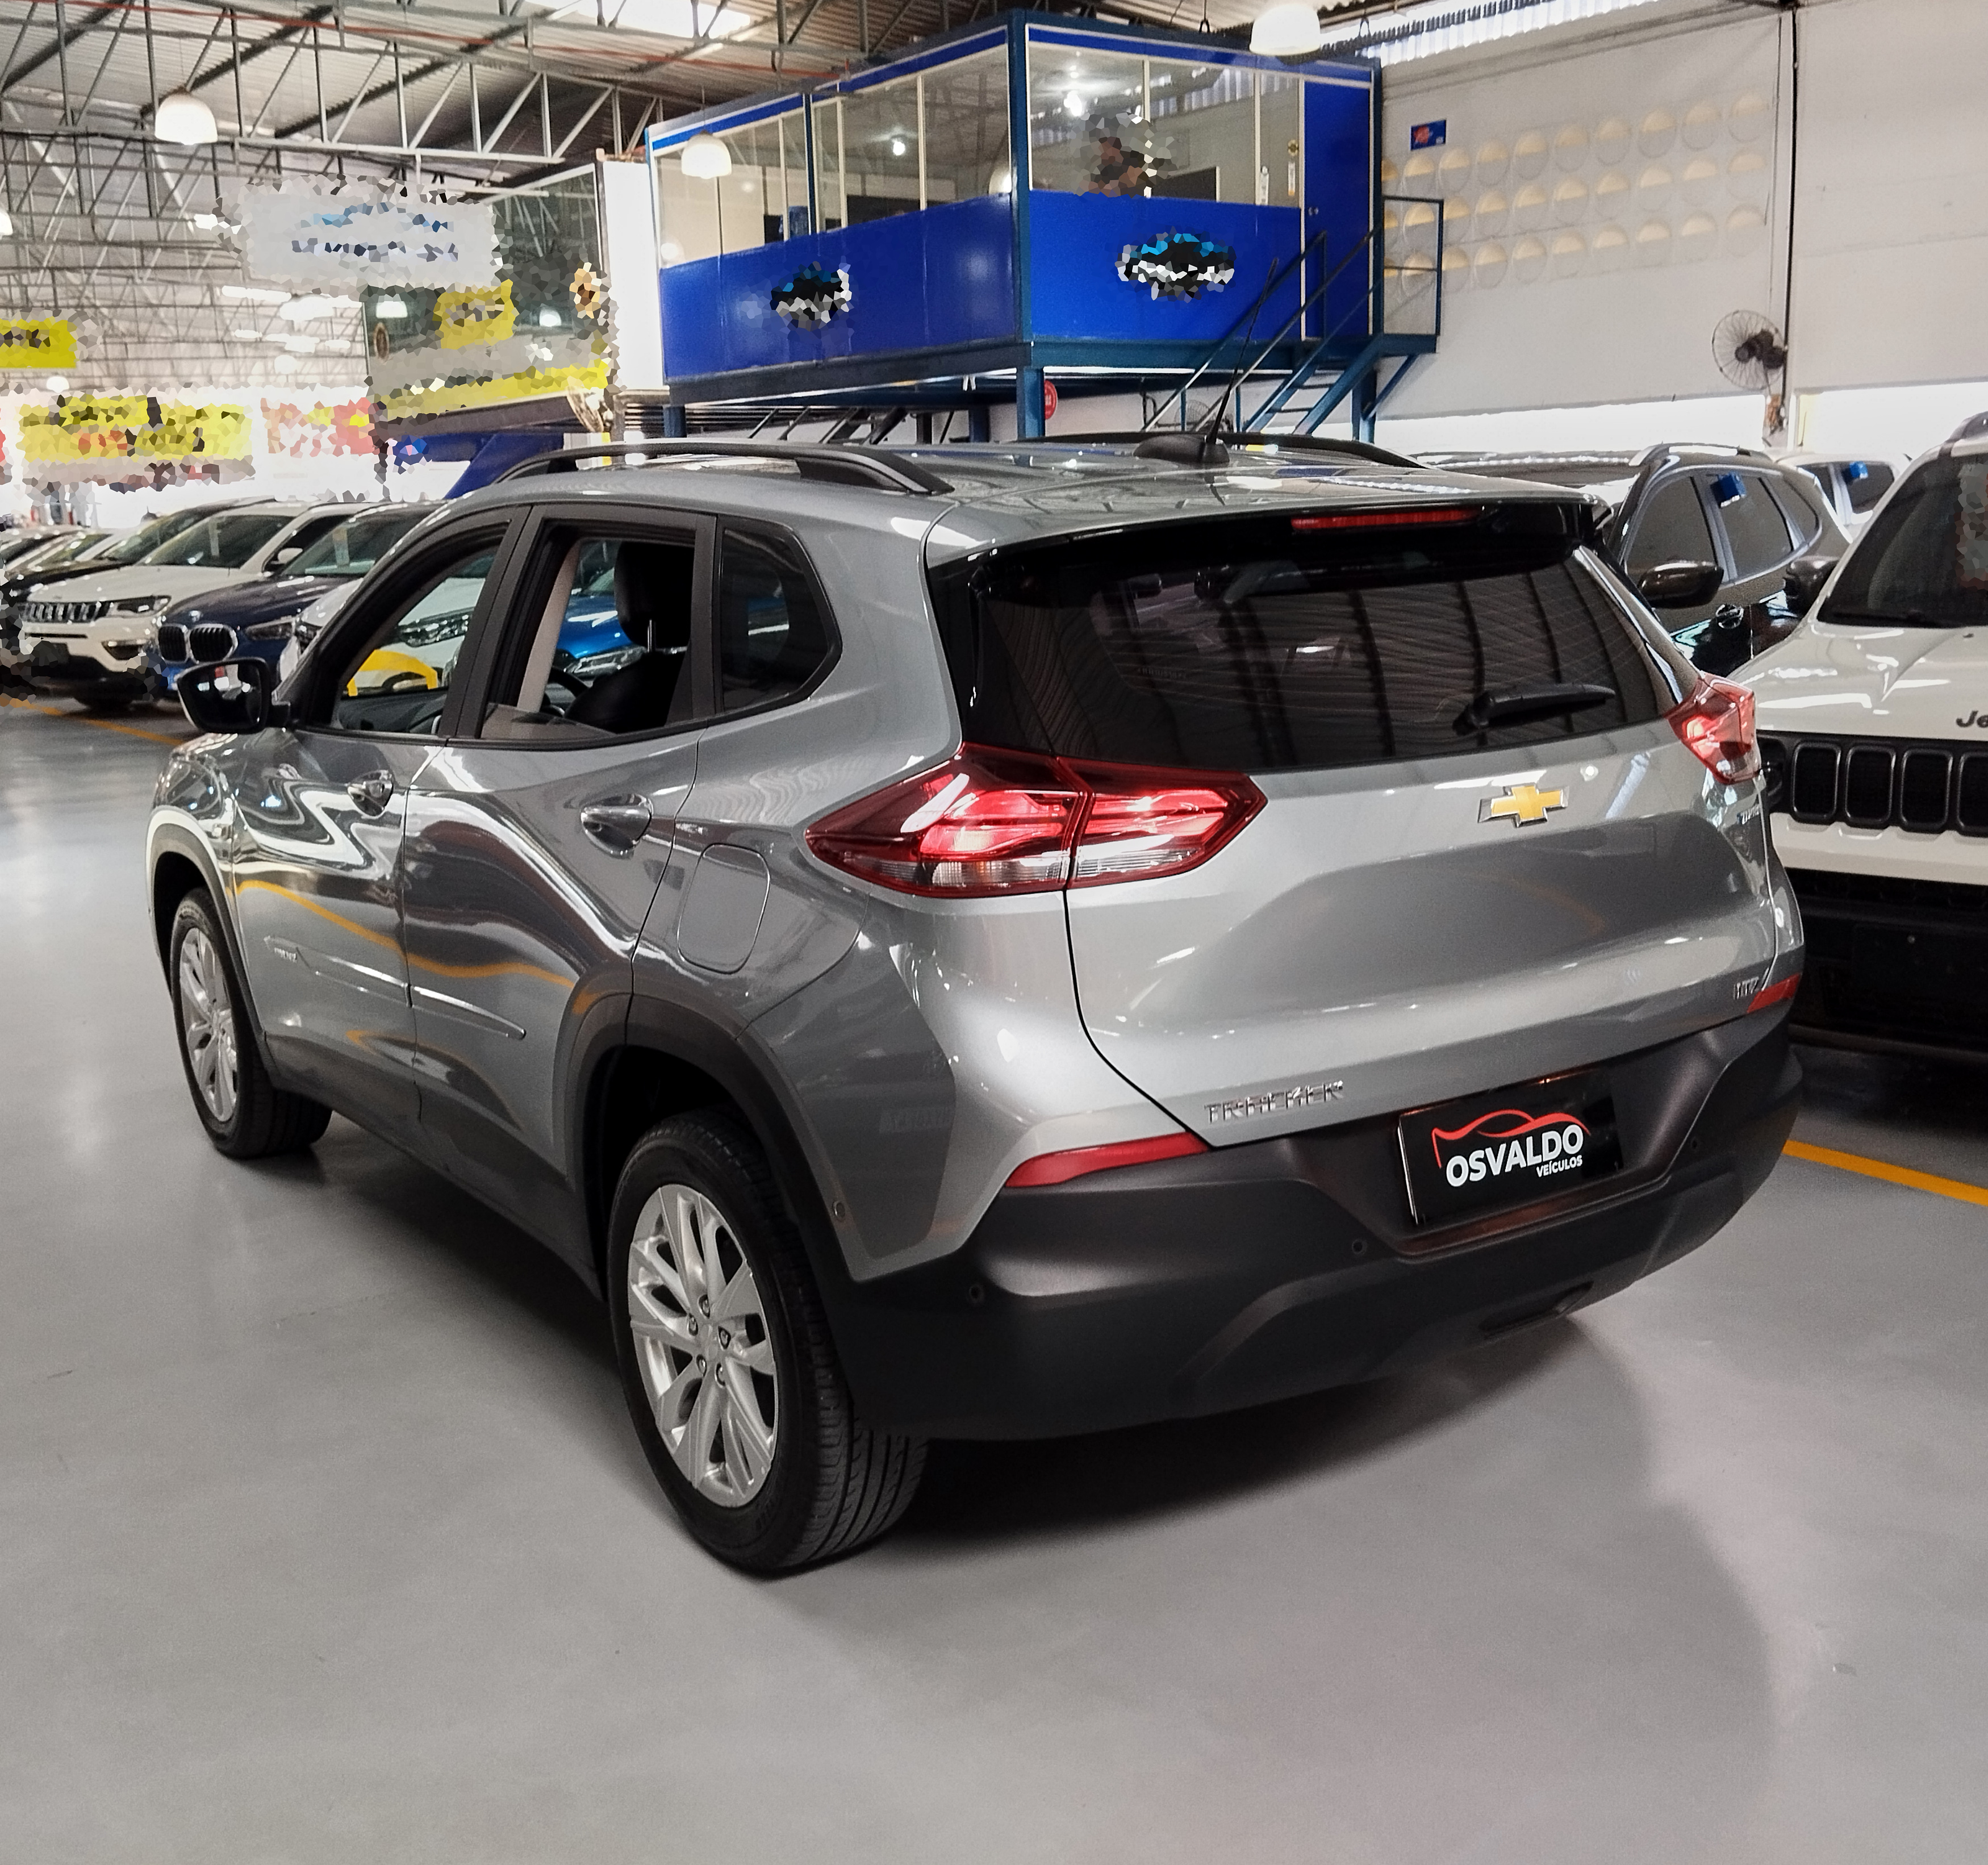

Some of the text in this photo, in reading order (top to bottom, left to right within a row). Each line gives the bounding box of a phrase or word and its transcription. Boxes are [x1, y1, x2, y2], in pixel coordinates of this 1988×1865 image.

[1204, 1079, 1344, 1124] TRACKER
[1446, 1124, 1584, 1187] OSVALDO
[1536, 1155, 1582, 1178] VEÍCULOS
